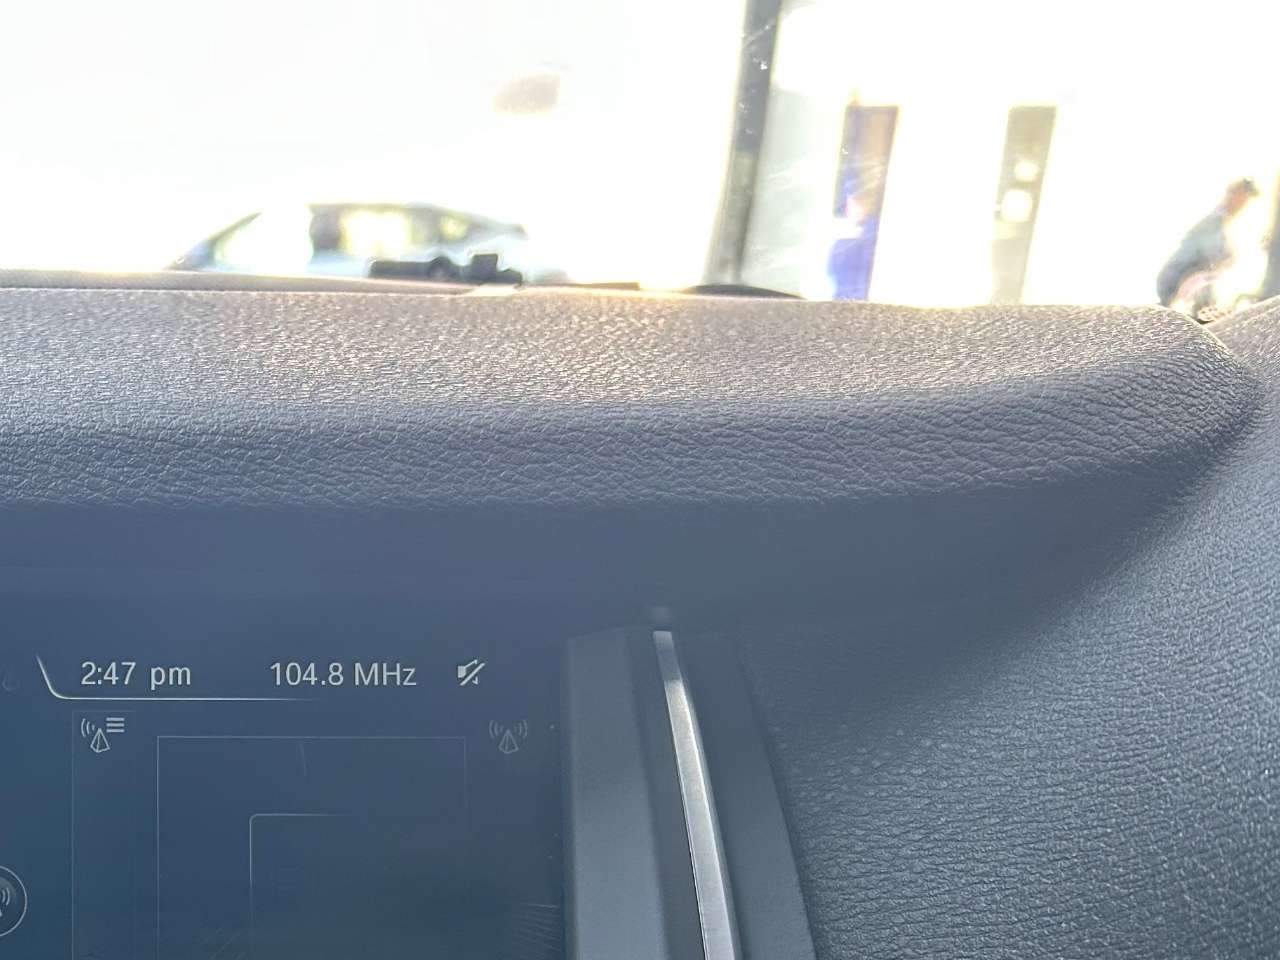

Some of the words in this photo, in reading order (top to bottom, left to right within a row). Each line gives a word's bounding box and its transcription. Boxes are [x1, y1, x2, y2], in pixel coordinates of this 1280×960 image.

[80, 661, 137, 686] 2:47
[150, 664, 192, 691] pm
[269, 661, 345, 687] 104.8
[354, 662, 418, 687] MHz
